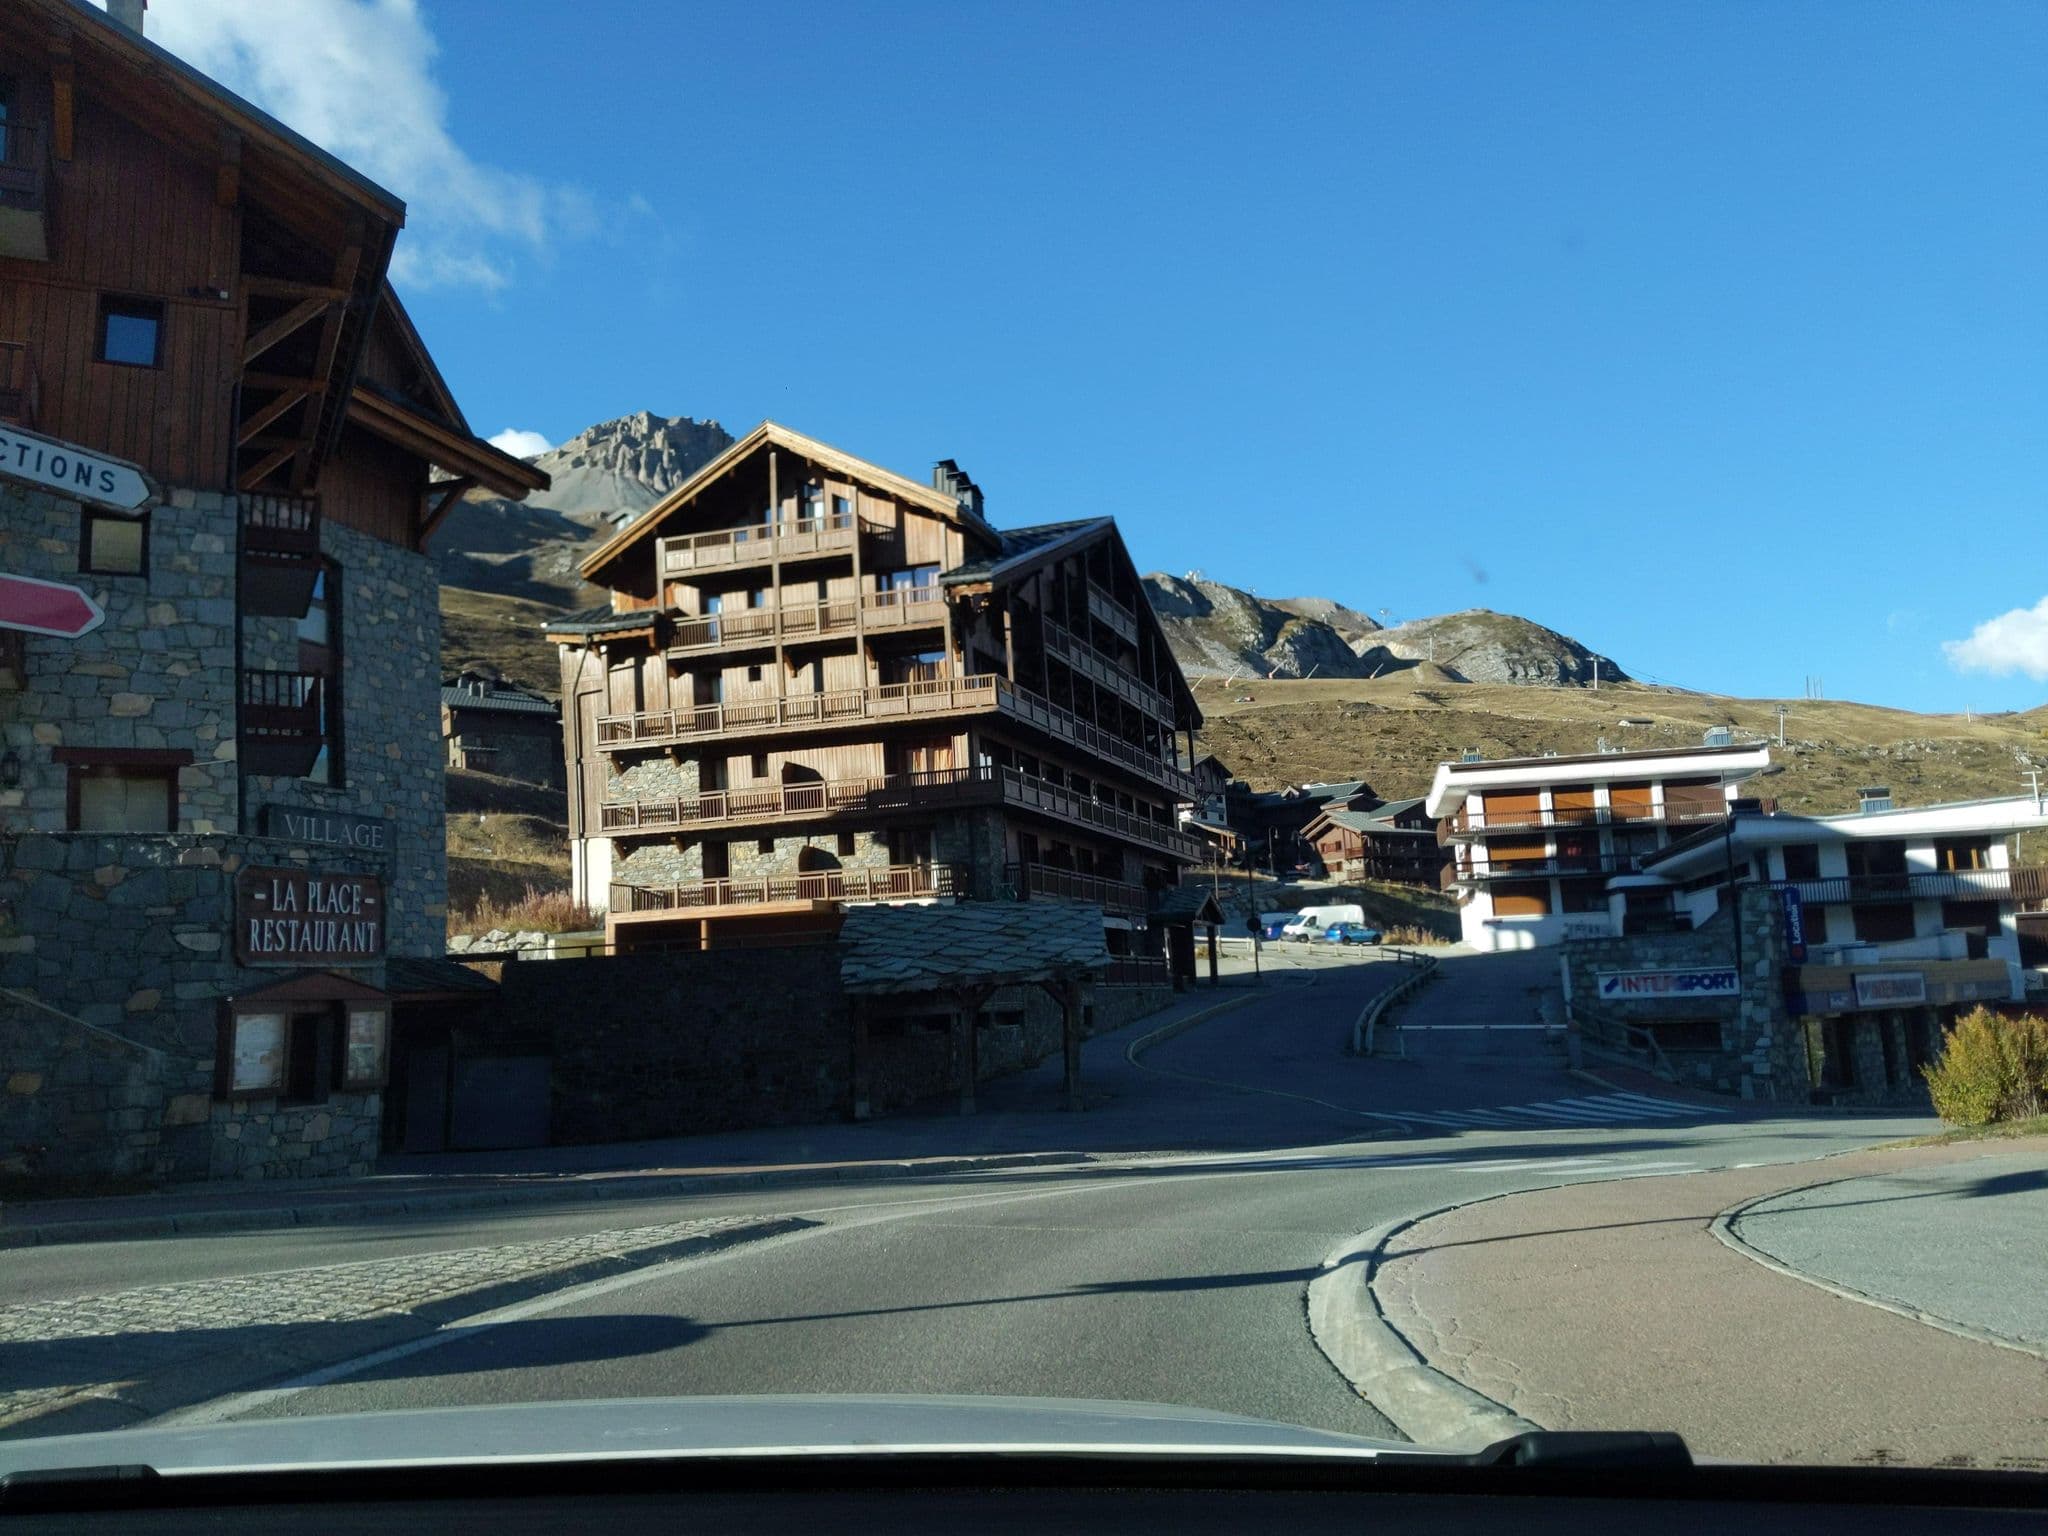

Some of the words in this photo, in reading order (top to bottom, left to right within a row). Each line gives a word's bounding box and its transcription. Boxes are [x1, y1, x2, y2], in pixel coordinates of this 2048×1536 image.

[284, 813, 384, 849] VILLAGE
[272, 879, 297, 912] LA
[307, 880, 362, 915] PLACE
[250, 918, 377, 953] RESTAURANT
[1791, 903, 1802, 945] Location
